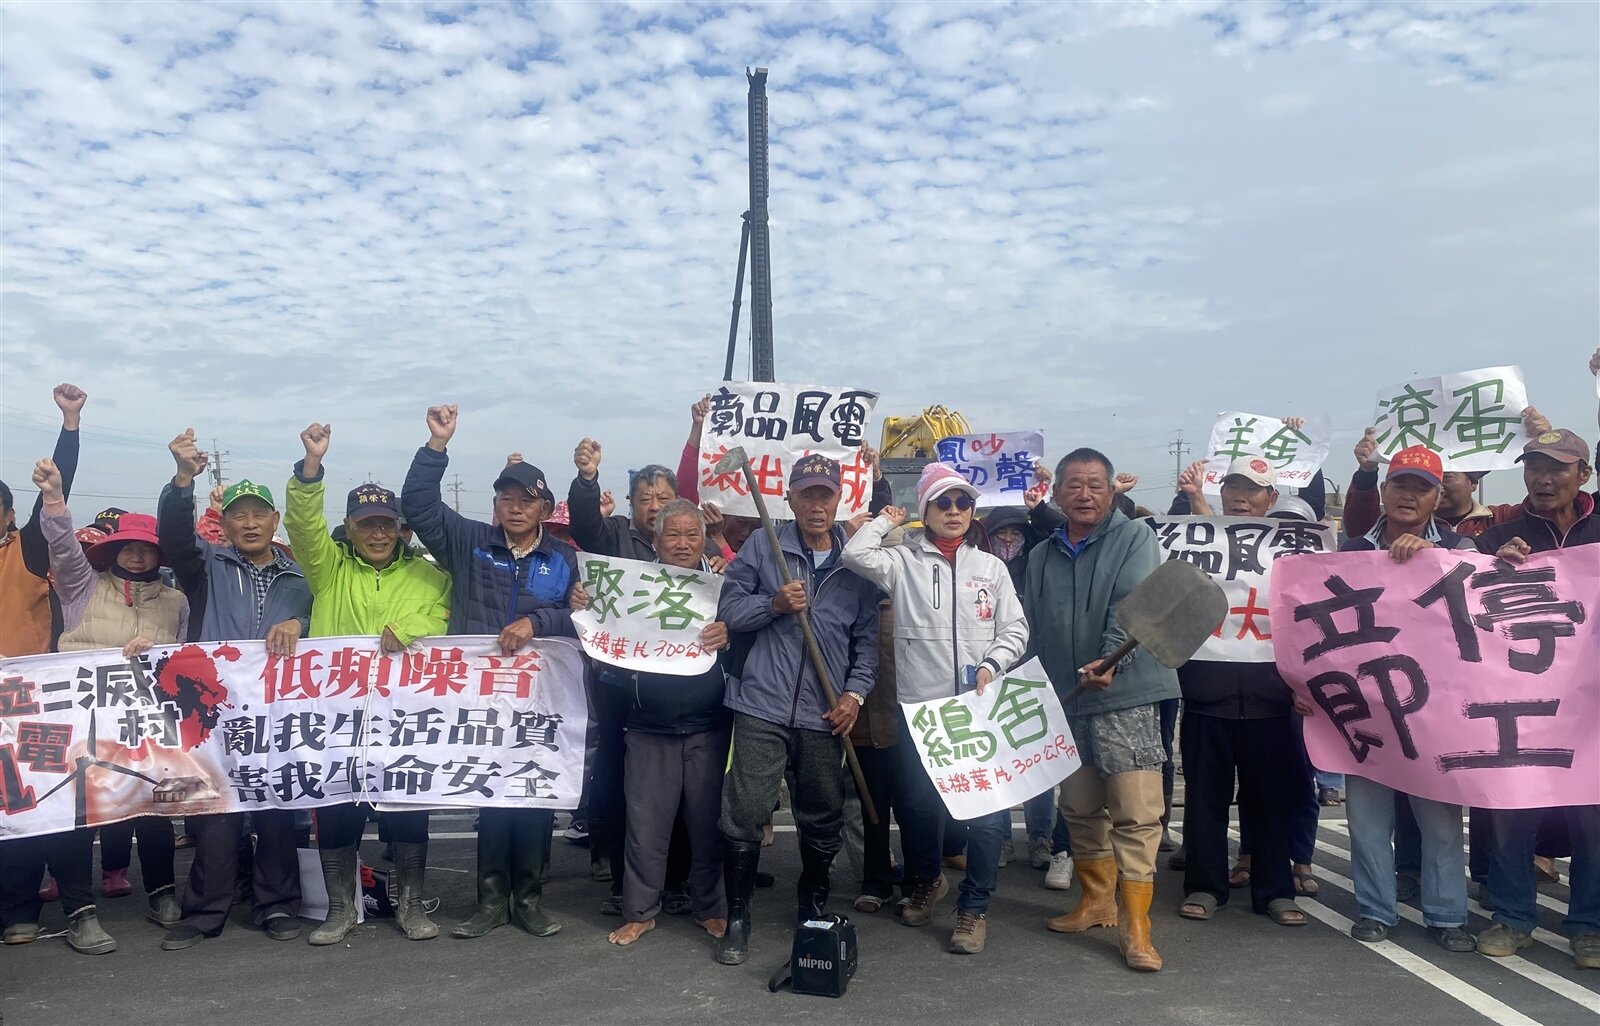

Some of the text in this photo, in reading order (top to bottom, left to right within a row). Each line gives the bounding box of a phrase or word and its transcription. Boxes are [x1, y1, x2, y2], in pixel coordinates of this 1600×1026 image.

[708, 386, 879, 447] 彰品風電
[1214, 417, 1312, 469] 羊舍
[1375, 378, 1522, 459] 滾蛋
[702, 444, 869, 513] 滾出城
[582, 560, 707, 631] 聚落
[259, 646, 542, 704] 低頻噪音
[1412, 556, 1586, 774] 停工
[222, 706, 564, 755] 亂我生活品質
[228, 754, 561, 803] 害我生命安全
